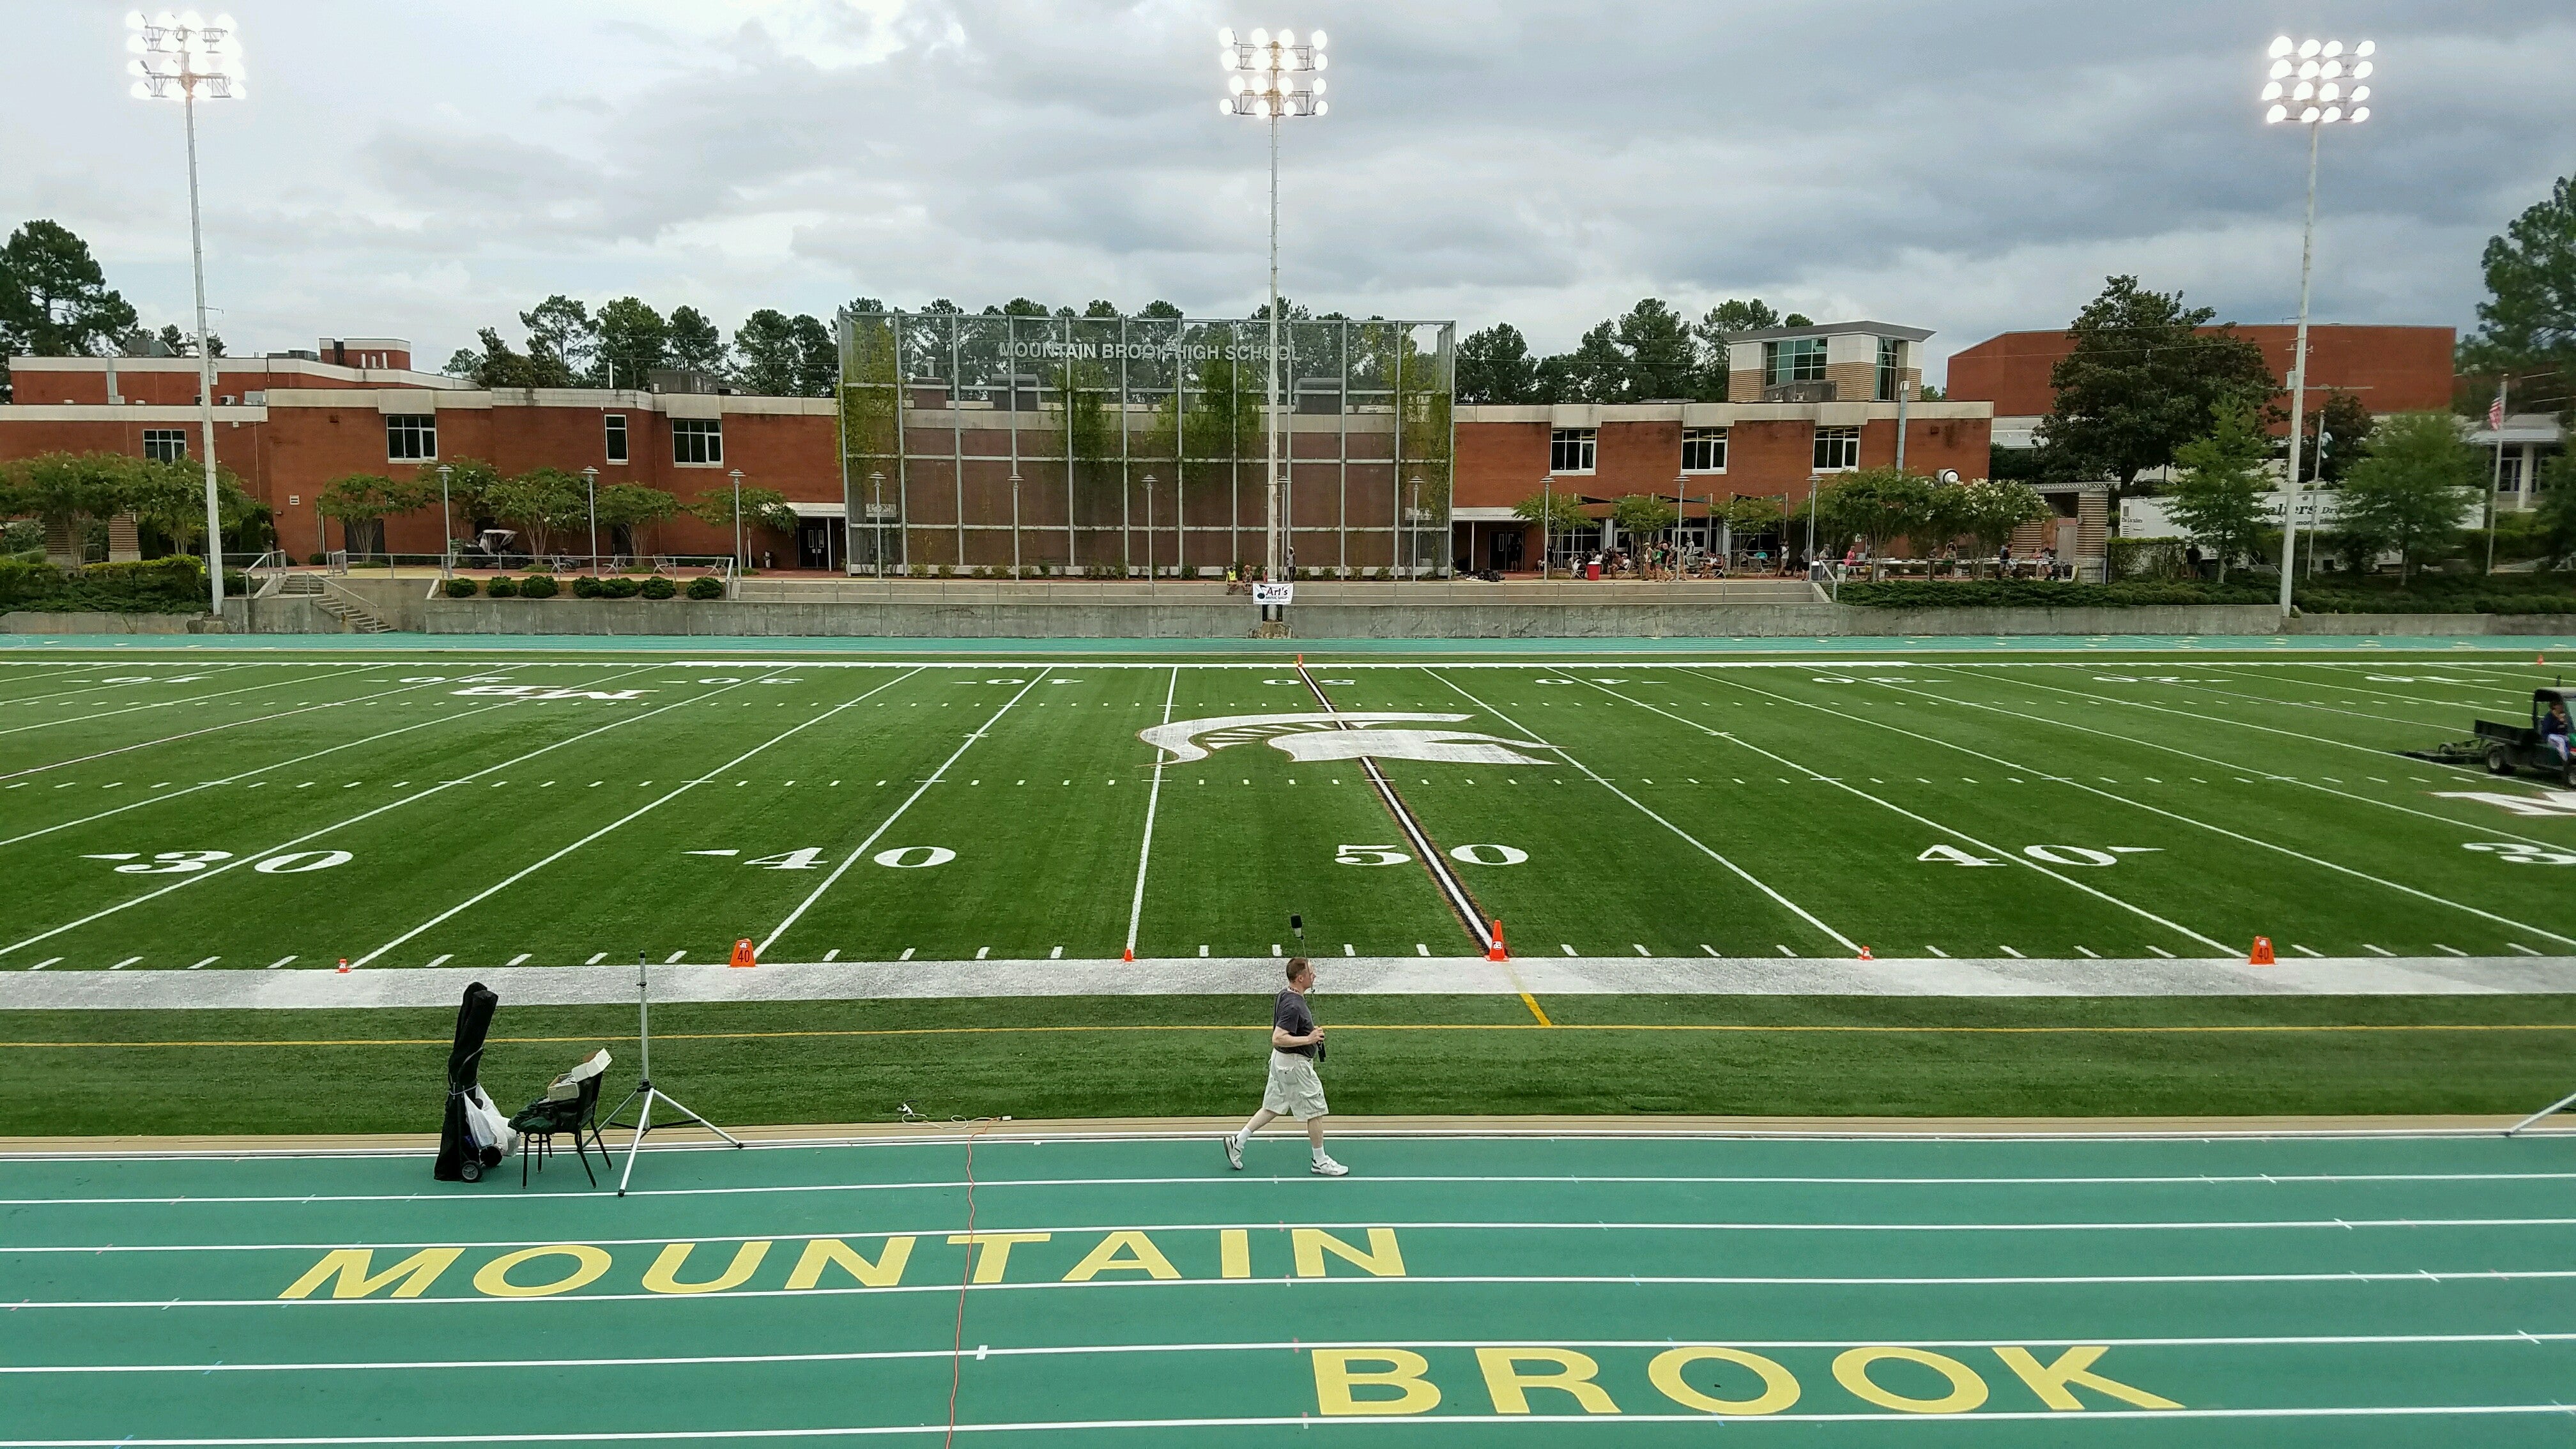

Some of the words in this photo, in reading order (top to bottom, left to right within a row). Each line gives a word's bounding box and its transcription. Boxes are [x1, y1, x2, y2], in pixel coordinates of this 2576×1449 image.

[999, 342, 1096, 358] MOUNTAIN
[1102, 343, 1167, 360] BROOK
[1176, 344, 1219, 360] HIGH
[1266, 587, 1288, 595] Art's
[737, 949, 750, 963] 40
[2257, 947, 2269, 960] 40
[277, 1227, 1407, 1299] MOUNTAIN
[1311, 1346, 2186, 1416] BROOK
